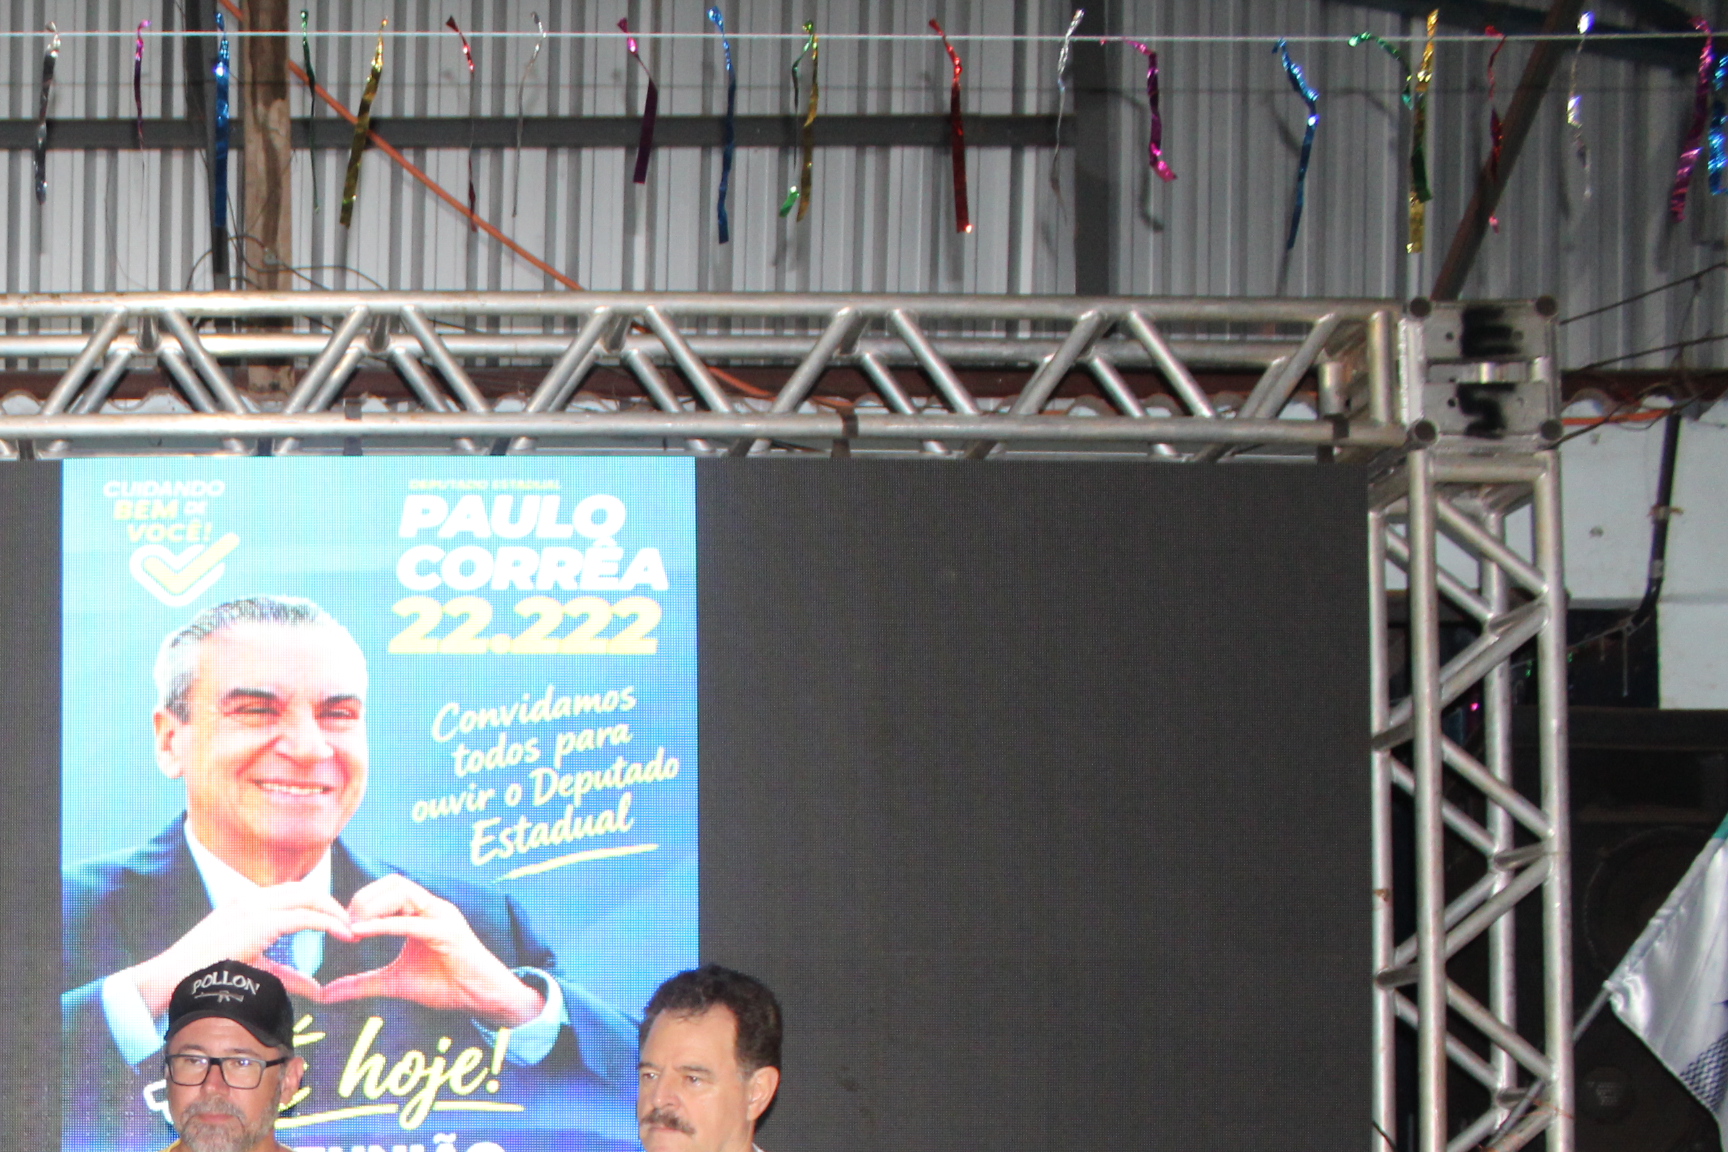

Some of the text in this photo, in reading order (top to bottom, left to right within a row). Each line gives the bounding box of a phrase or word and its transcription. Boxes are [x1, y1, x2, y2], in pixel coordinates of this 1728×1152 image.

[103, 480, 226, 498] CUIDANDO
[115, 499, 178, 520] BEM
[399, 494, 626, 538] PAULO
[128, 518, 213, 543] VOCÊ!
[396, 537, 670, 591] CORRÊA
[387, 596, 663, 655] 22.222
[431, 684, 637, 742] Convidamos
[452, 723, 633, 778] todos para
[412, 746, 679, 823] ouvir o Deputado
[470, 791, 635, 866] Estadual
[191, 970, 261, 996] POLLON
[338, 1016, 511, 1130] hoje!
